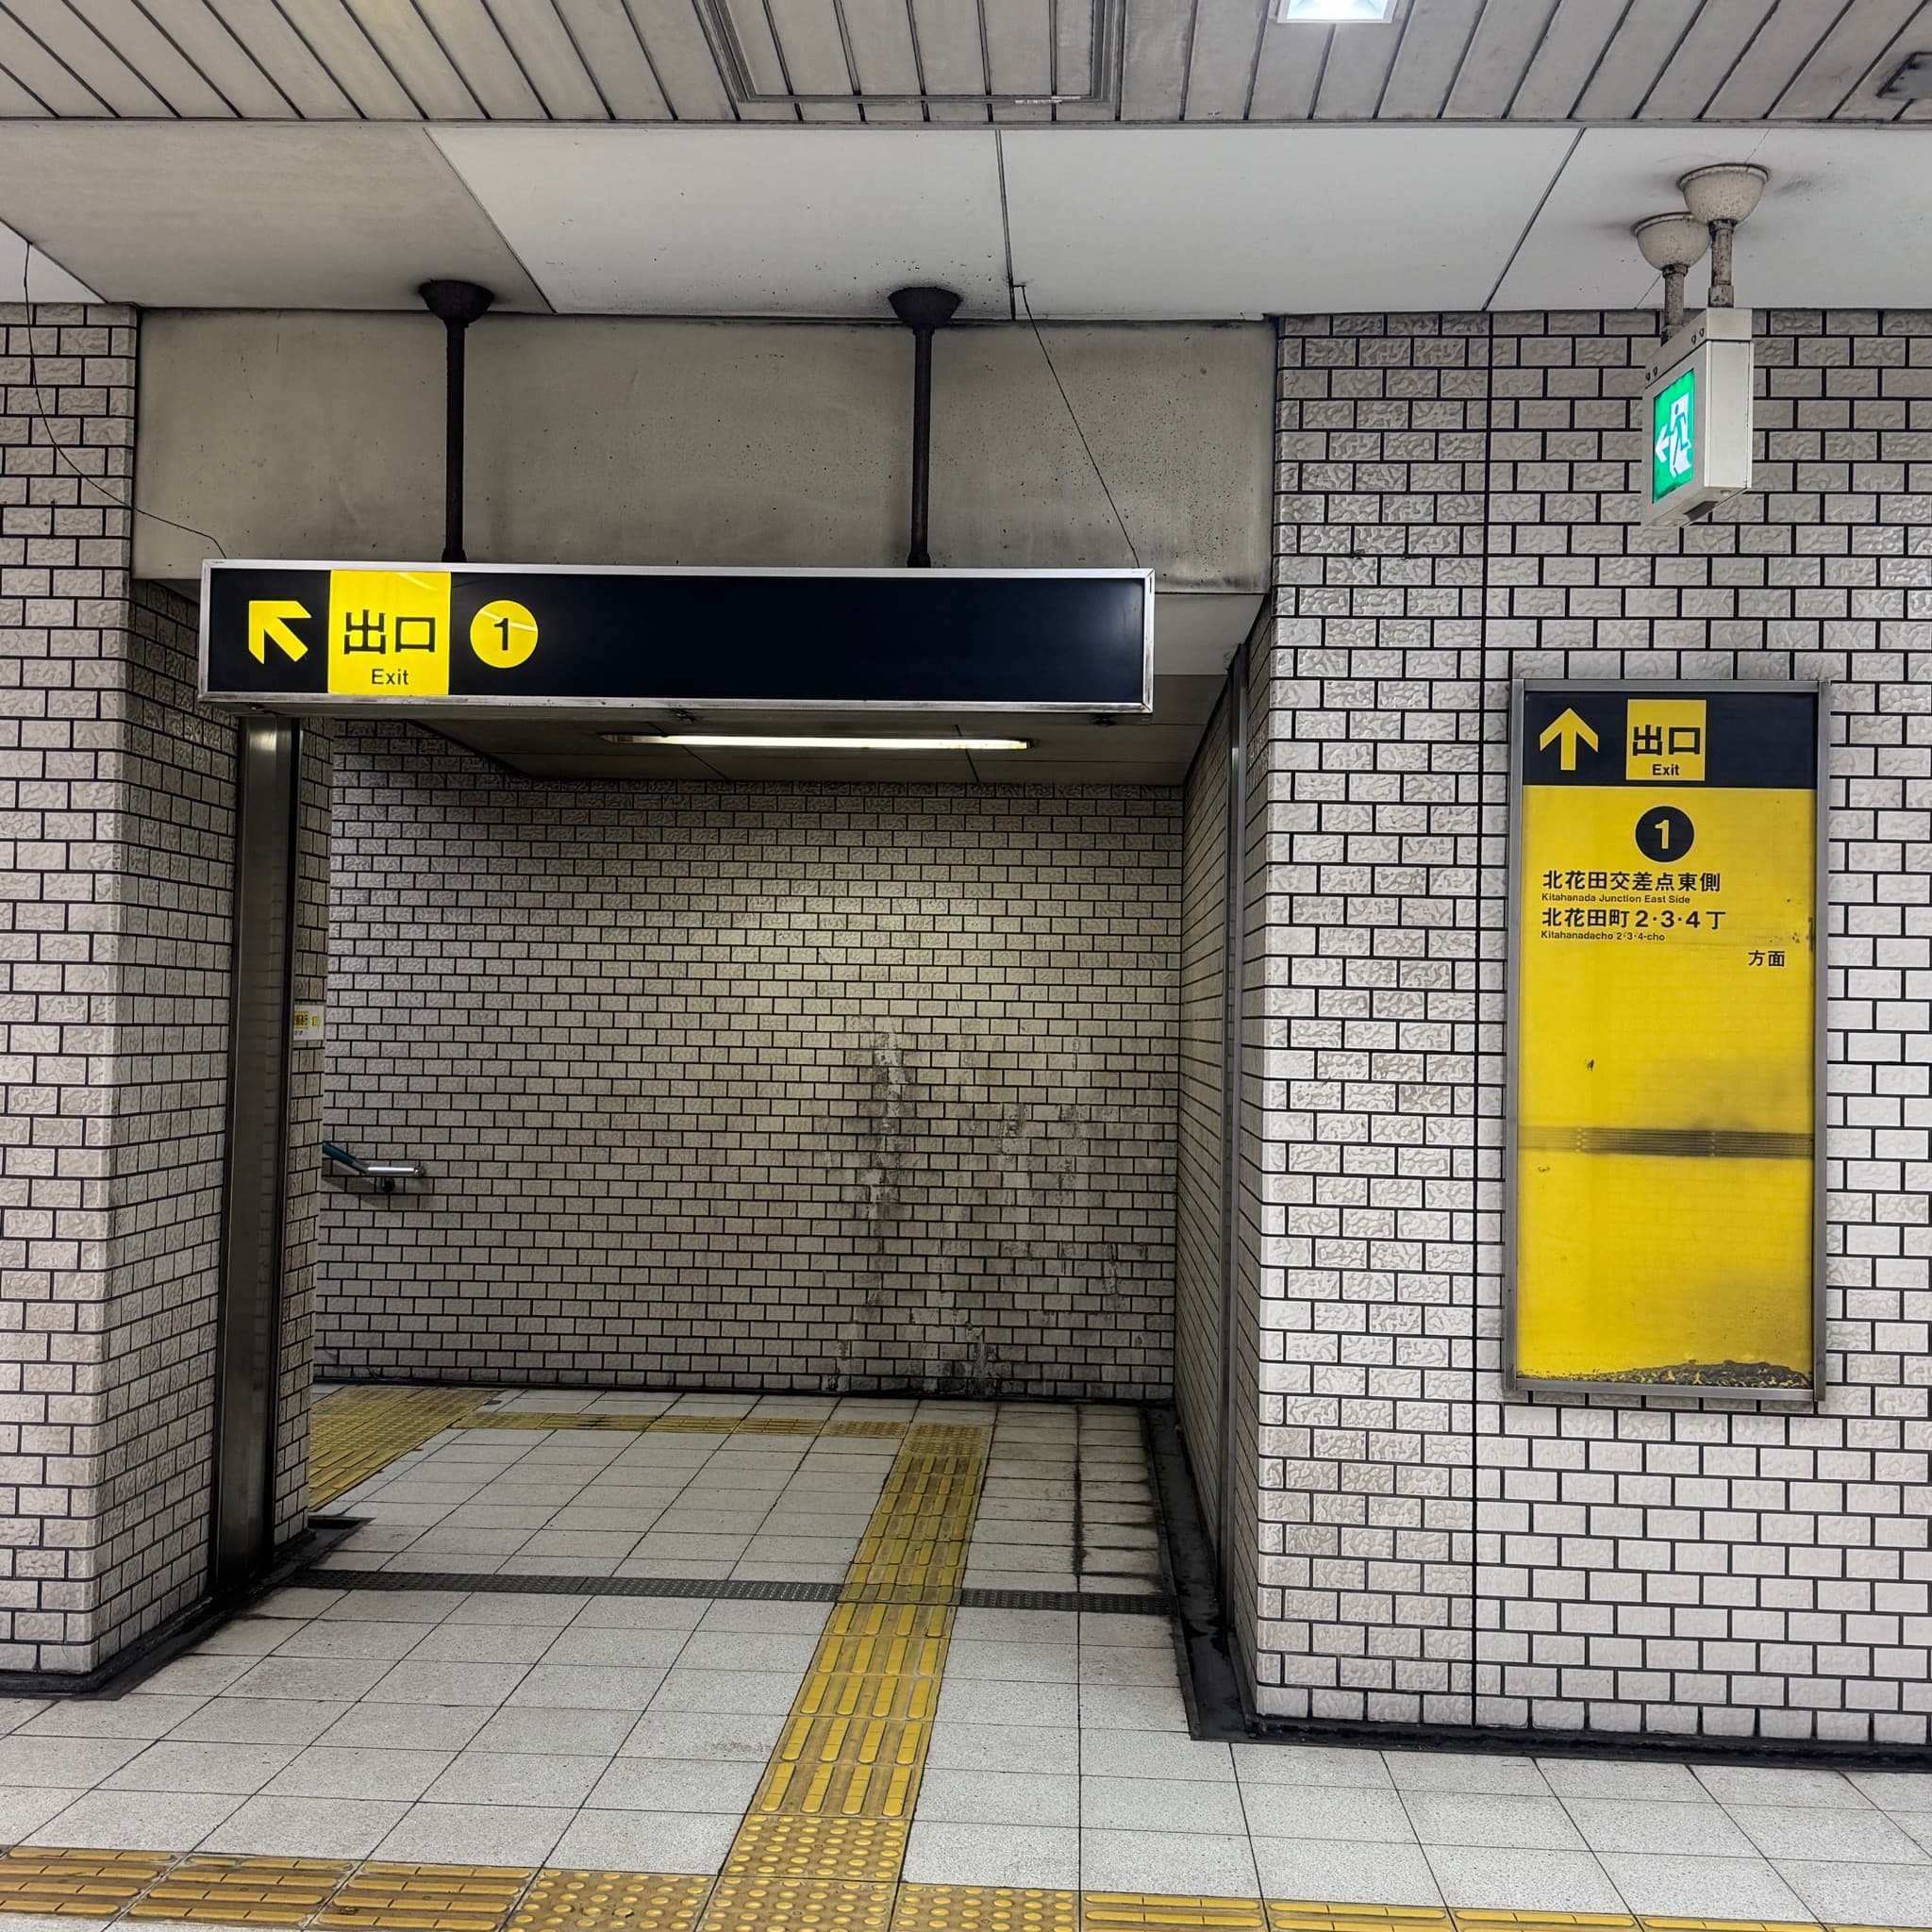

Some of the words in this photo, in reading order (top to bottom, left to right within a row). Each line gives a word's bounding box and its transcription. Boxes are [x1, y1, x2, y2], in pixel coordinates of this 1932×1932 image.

[343, 608, 436, 656] 出口
[493, 617, 509, 652] 1
[371, 668, 409, 686] Exit
[1632, 724, 1701, 756] 出口
[1652, 763, 1680, 776] Exit
[1655, 819, 1669, 850] 1
[1542, 870, 1722, 892] 北花田交差点東側
[1541, 892, 1596, 903] Kitahanada
[1599, 893, 1641, 904] Junction
[1644, 894, 1667, 904] East
[1668, 894, 1690, 905] Side
[1541, 930, 1614, 941] Kitahanadacho
[1747, 950, 1786, 968] 方面
